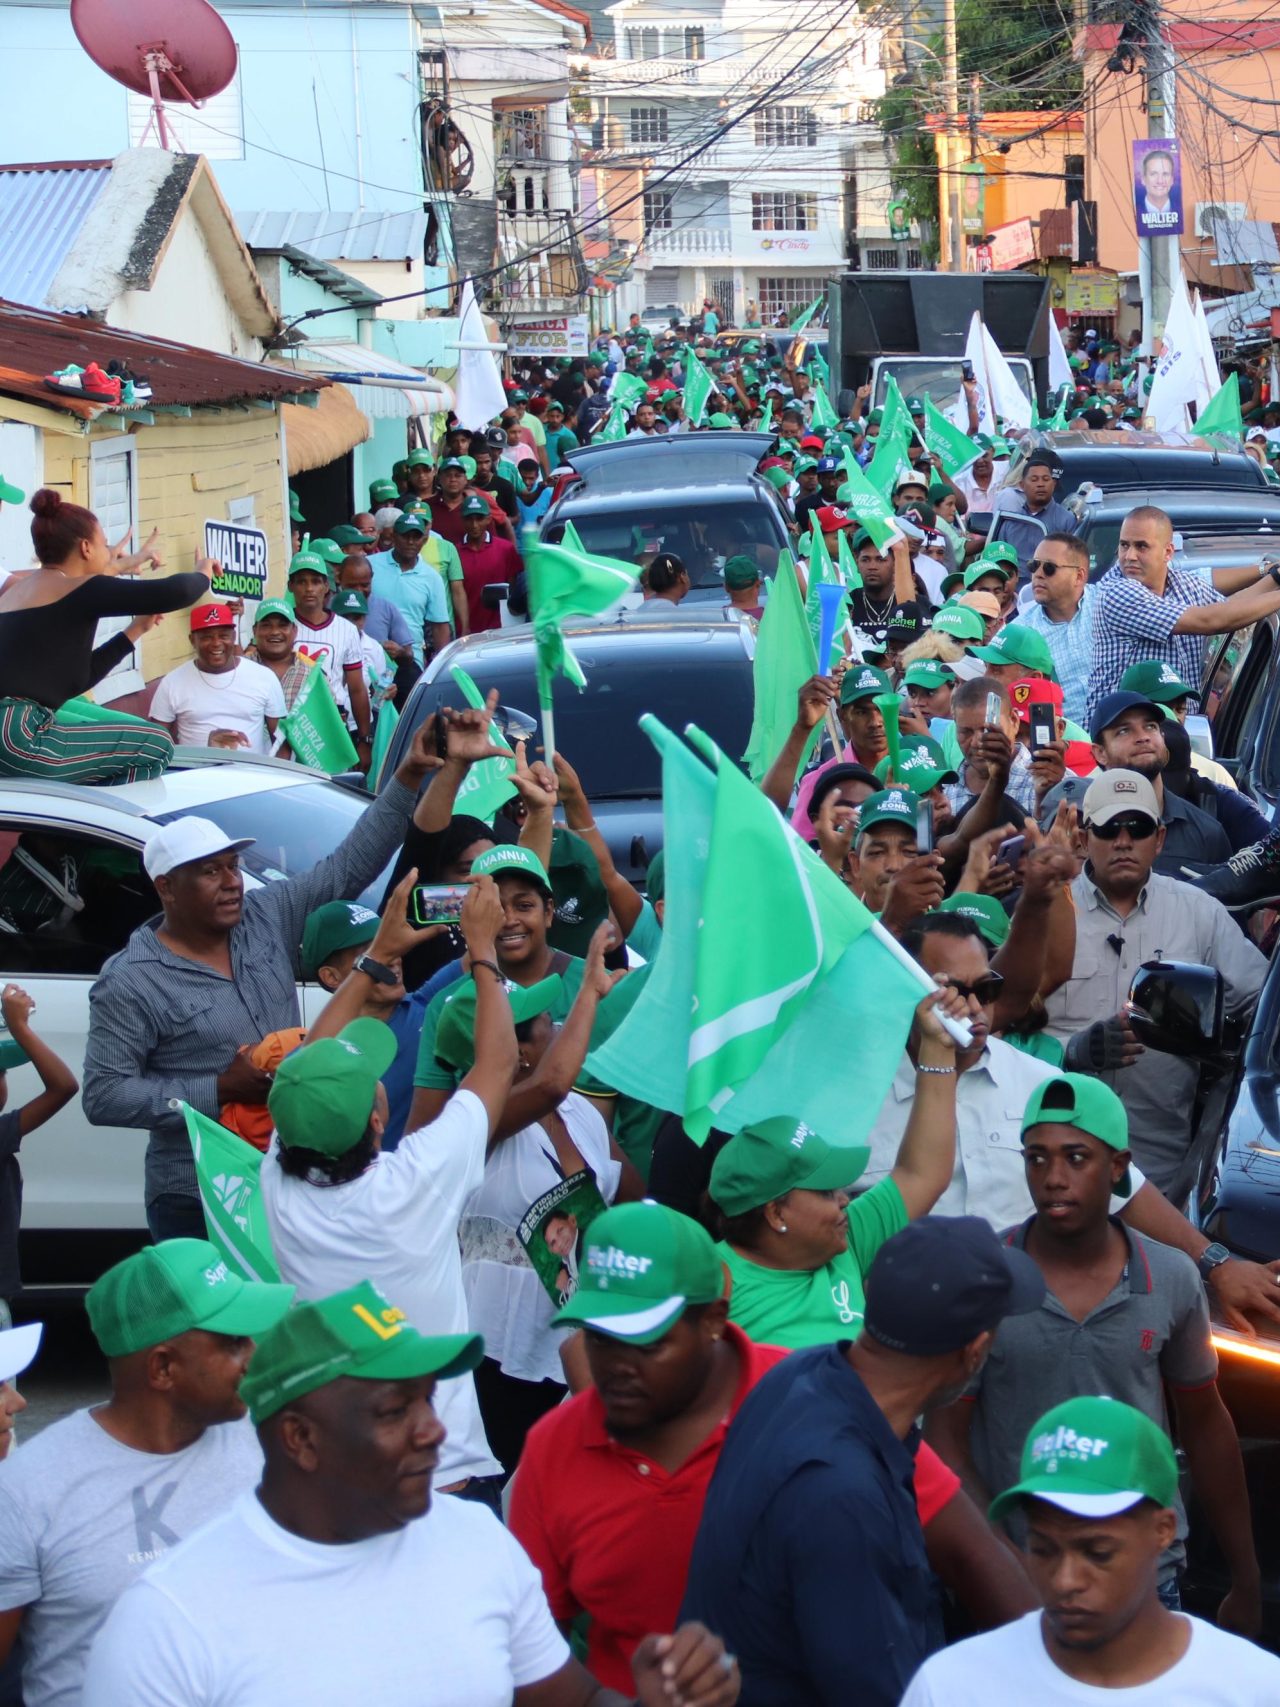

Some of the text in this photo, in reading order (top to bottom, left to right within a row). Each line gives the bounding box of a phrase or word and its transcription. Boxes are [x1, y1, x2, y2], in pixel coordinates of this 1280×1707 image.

[1141, 211, 1179, 224] WALTER
[206, 527, 266, 576] WALTER
[212, 572, 262, 596] SENADOR
[877, 802, 912, 813] LEONEL
[480, 850, 530, 870] IVANNIA
[525, 1172, 587, 1224] PARTIDO FUERZA
[539, 1189, 569, 1214] PUEBLO
[129, 1480, 182, 1553] K
